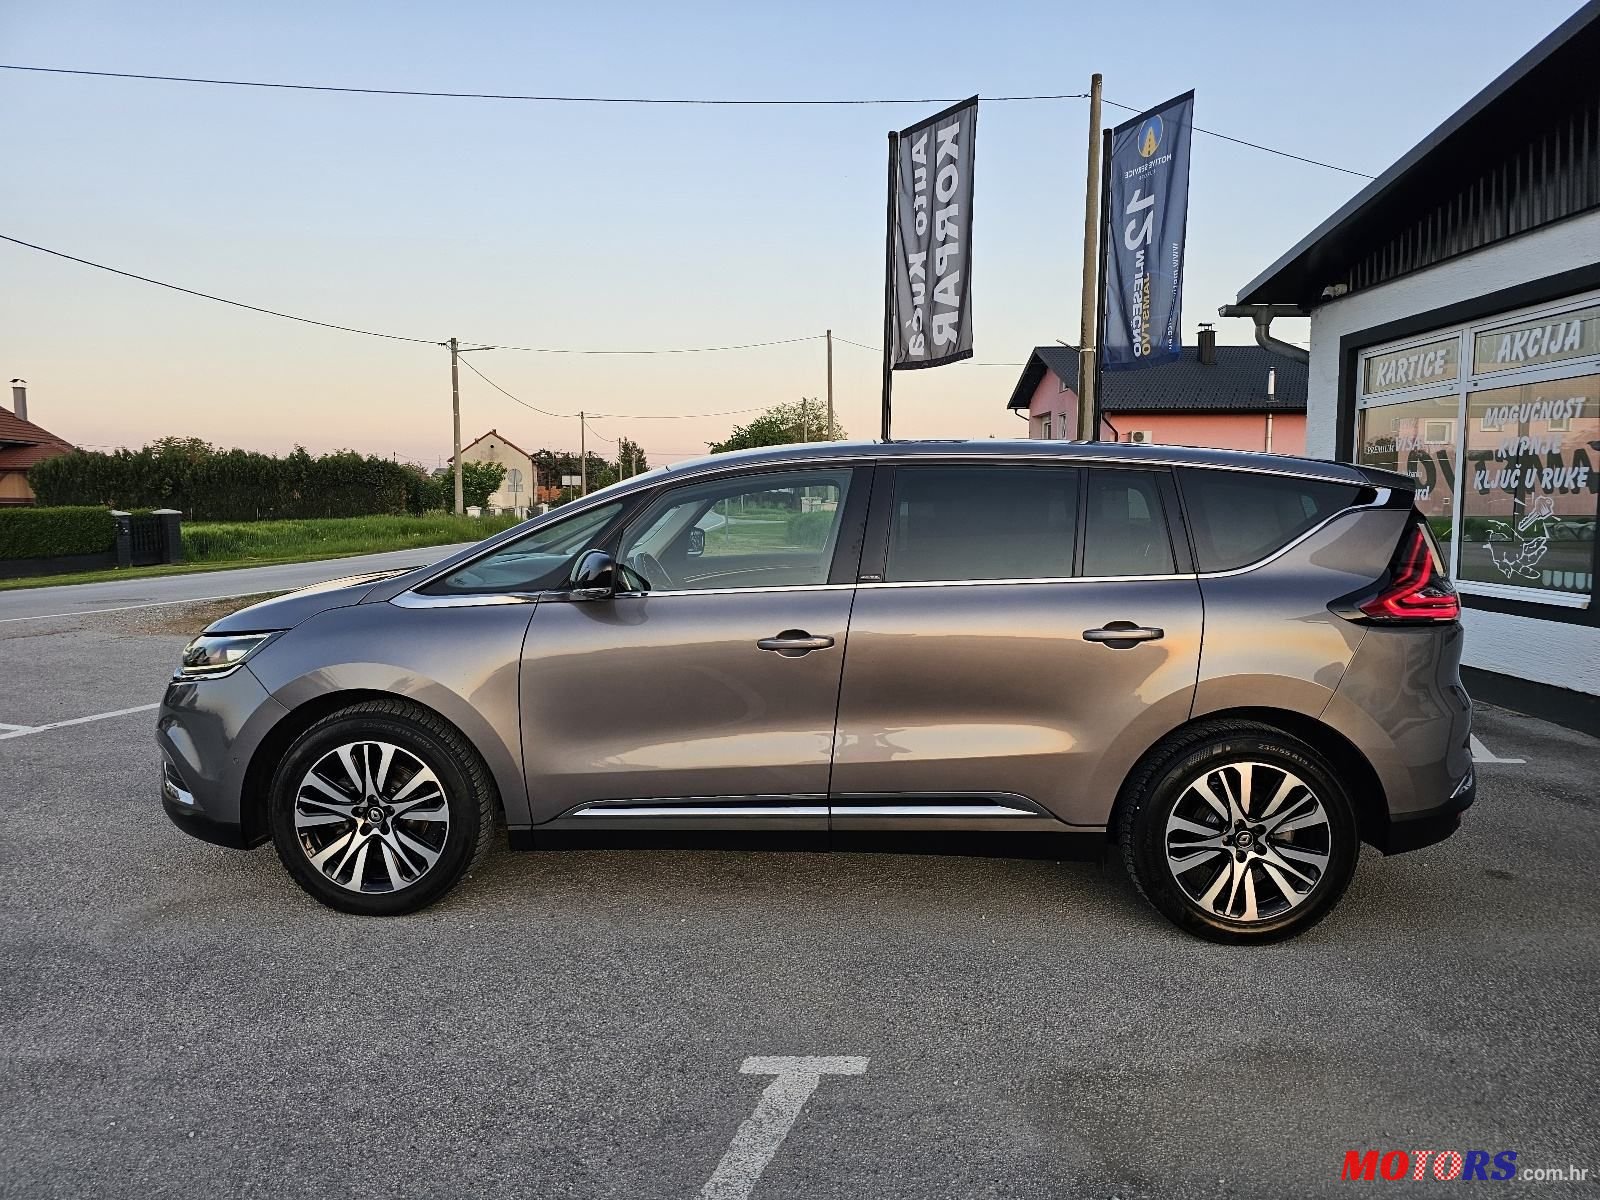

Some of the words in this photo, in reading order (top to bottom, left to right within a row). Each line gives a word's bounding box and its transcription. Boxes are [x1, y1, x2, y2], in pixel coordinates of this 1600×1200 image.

[1496, 319, 1581, 363] AKCIJA
[1375, 349, 1447, 387] KARTICE
[1484, 396, 1587, 426] MOGUĆNOST
[1497, 433, 1563, 458] KUPNJE
[1473, 463, 1522, 490] KLJUČ
[1524, 468, 1538, 489] U
[1541, 466, 1590, 489] RUKE
